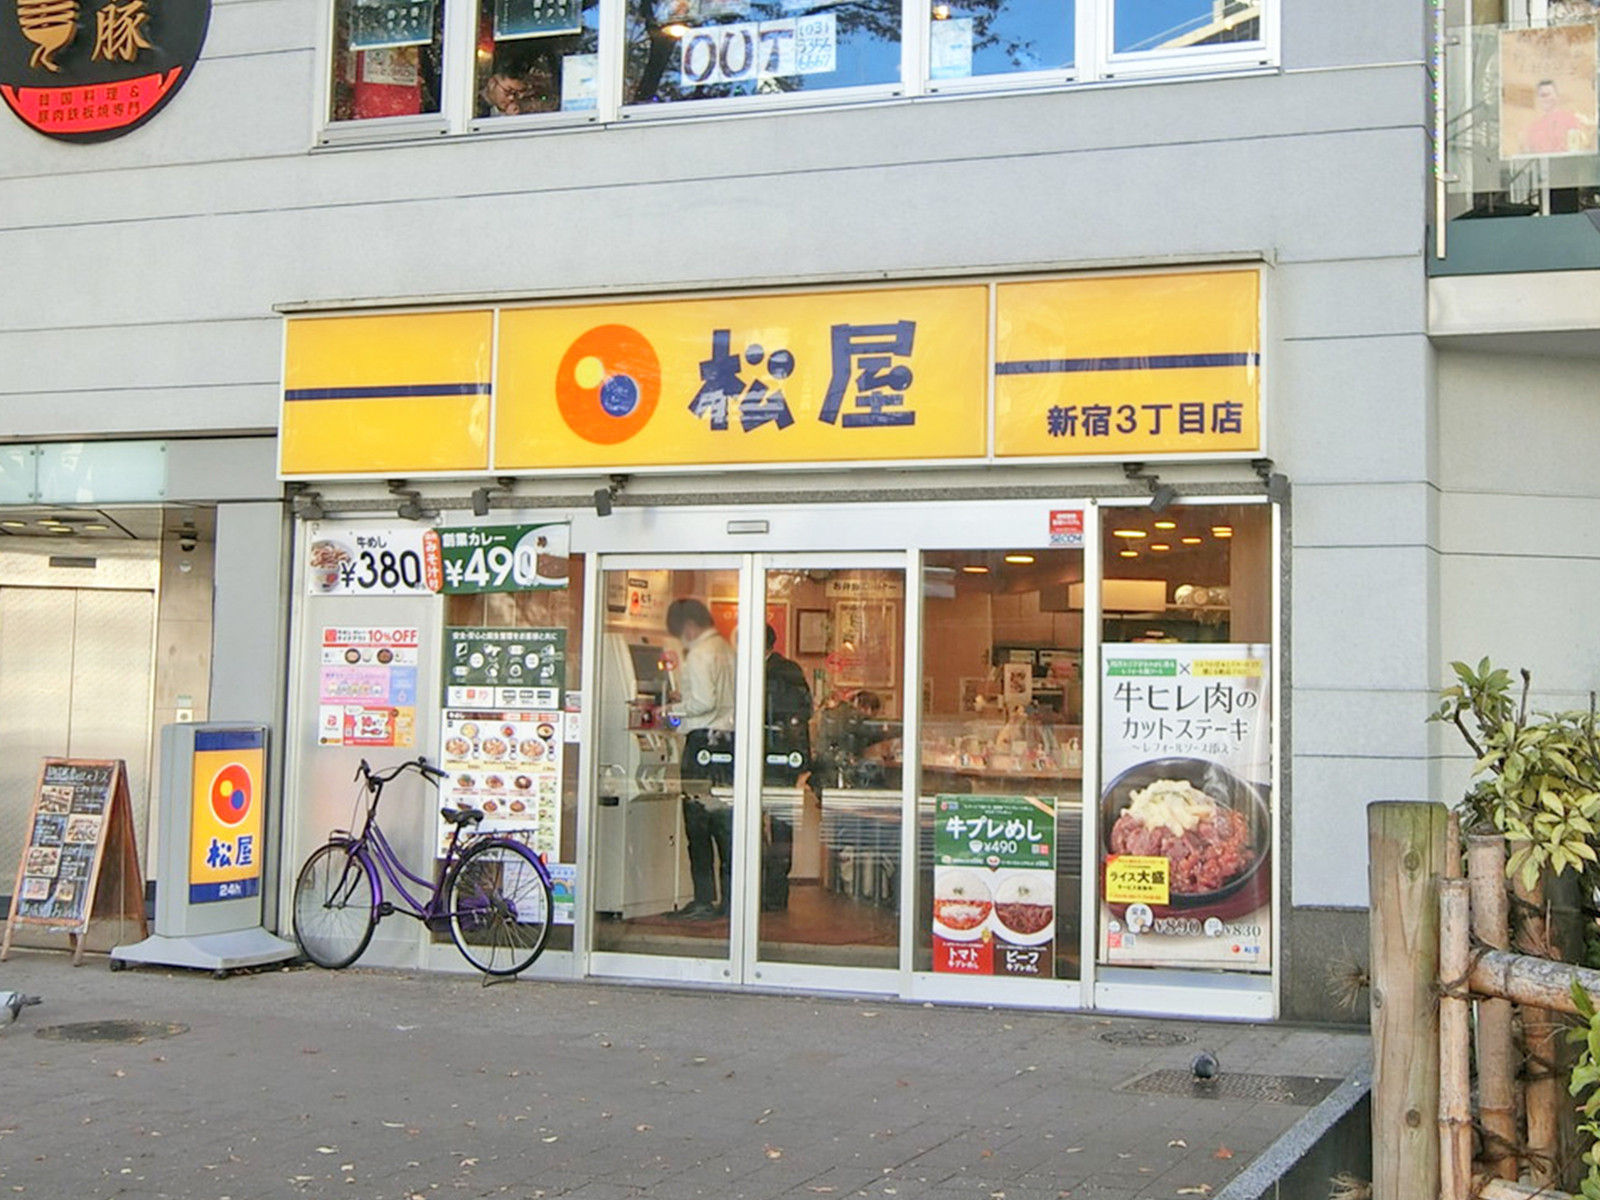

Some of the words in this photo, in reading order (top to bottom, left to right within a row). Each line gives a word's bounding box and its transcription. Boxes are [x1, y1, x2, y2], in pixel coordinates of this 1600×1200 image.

[92, 1, 153, 62] 豚
[684, 28, 794, 82] OUT
[688, 320, 916, 432] 松屋
[1047, 401, 1243, 437] 新宿3丁目店
[356, 536, 387, 549] 牛めし
[442, 532, 507, 547] 創業カレー
[341, 550, 421, 589] ¥380
[444, 545, 538, 588] ¥490
[1113, 681, 1258, 714] 牛ヒレ肉の
[1122, 717, 1250, 742] カットステーキ
[946, 814, 1043, 841] 牛プレめし
[206, 835, 253, 868] 松屋
[219, 884, 242, 897] 24h
[1110, 870, 1165, 885] ライス大盛
[949, 947, 978, 961] トマト
[1006, 951, 1040, 964] ビーフ
